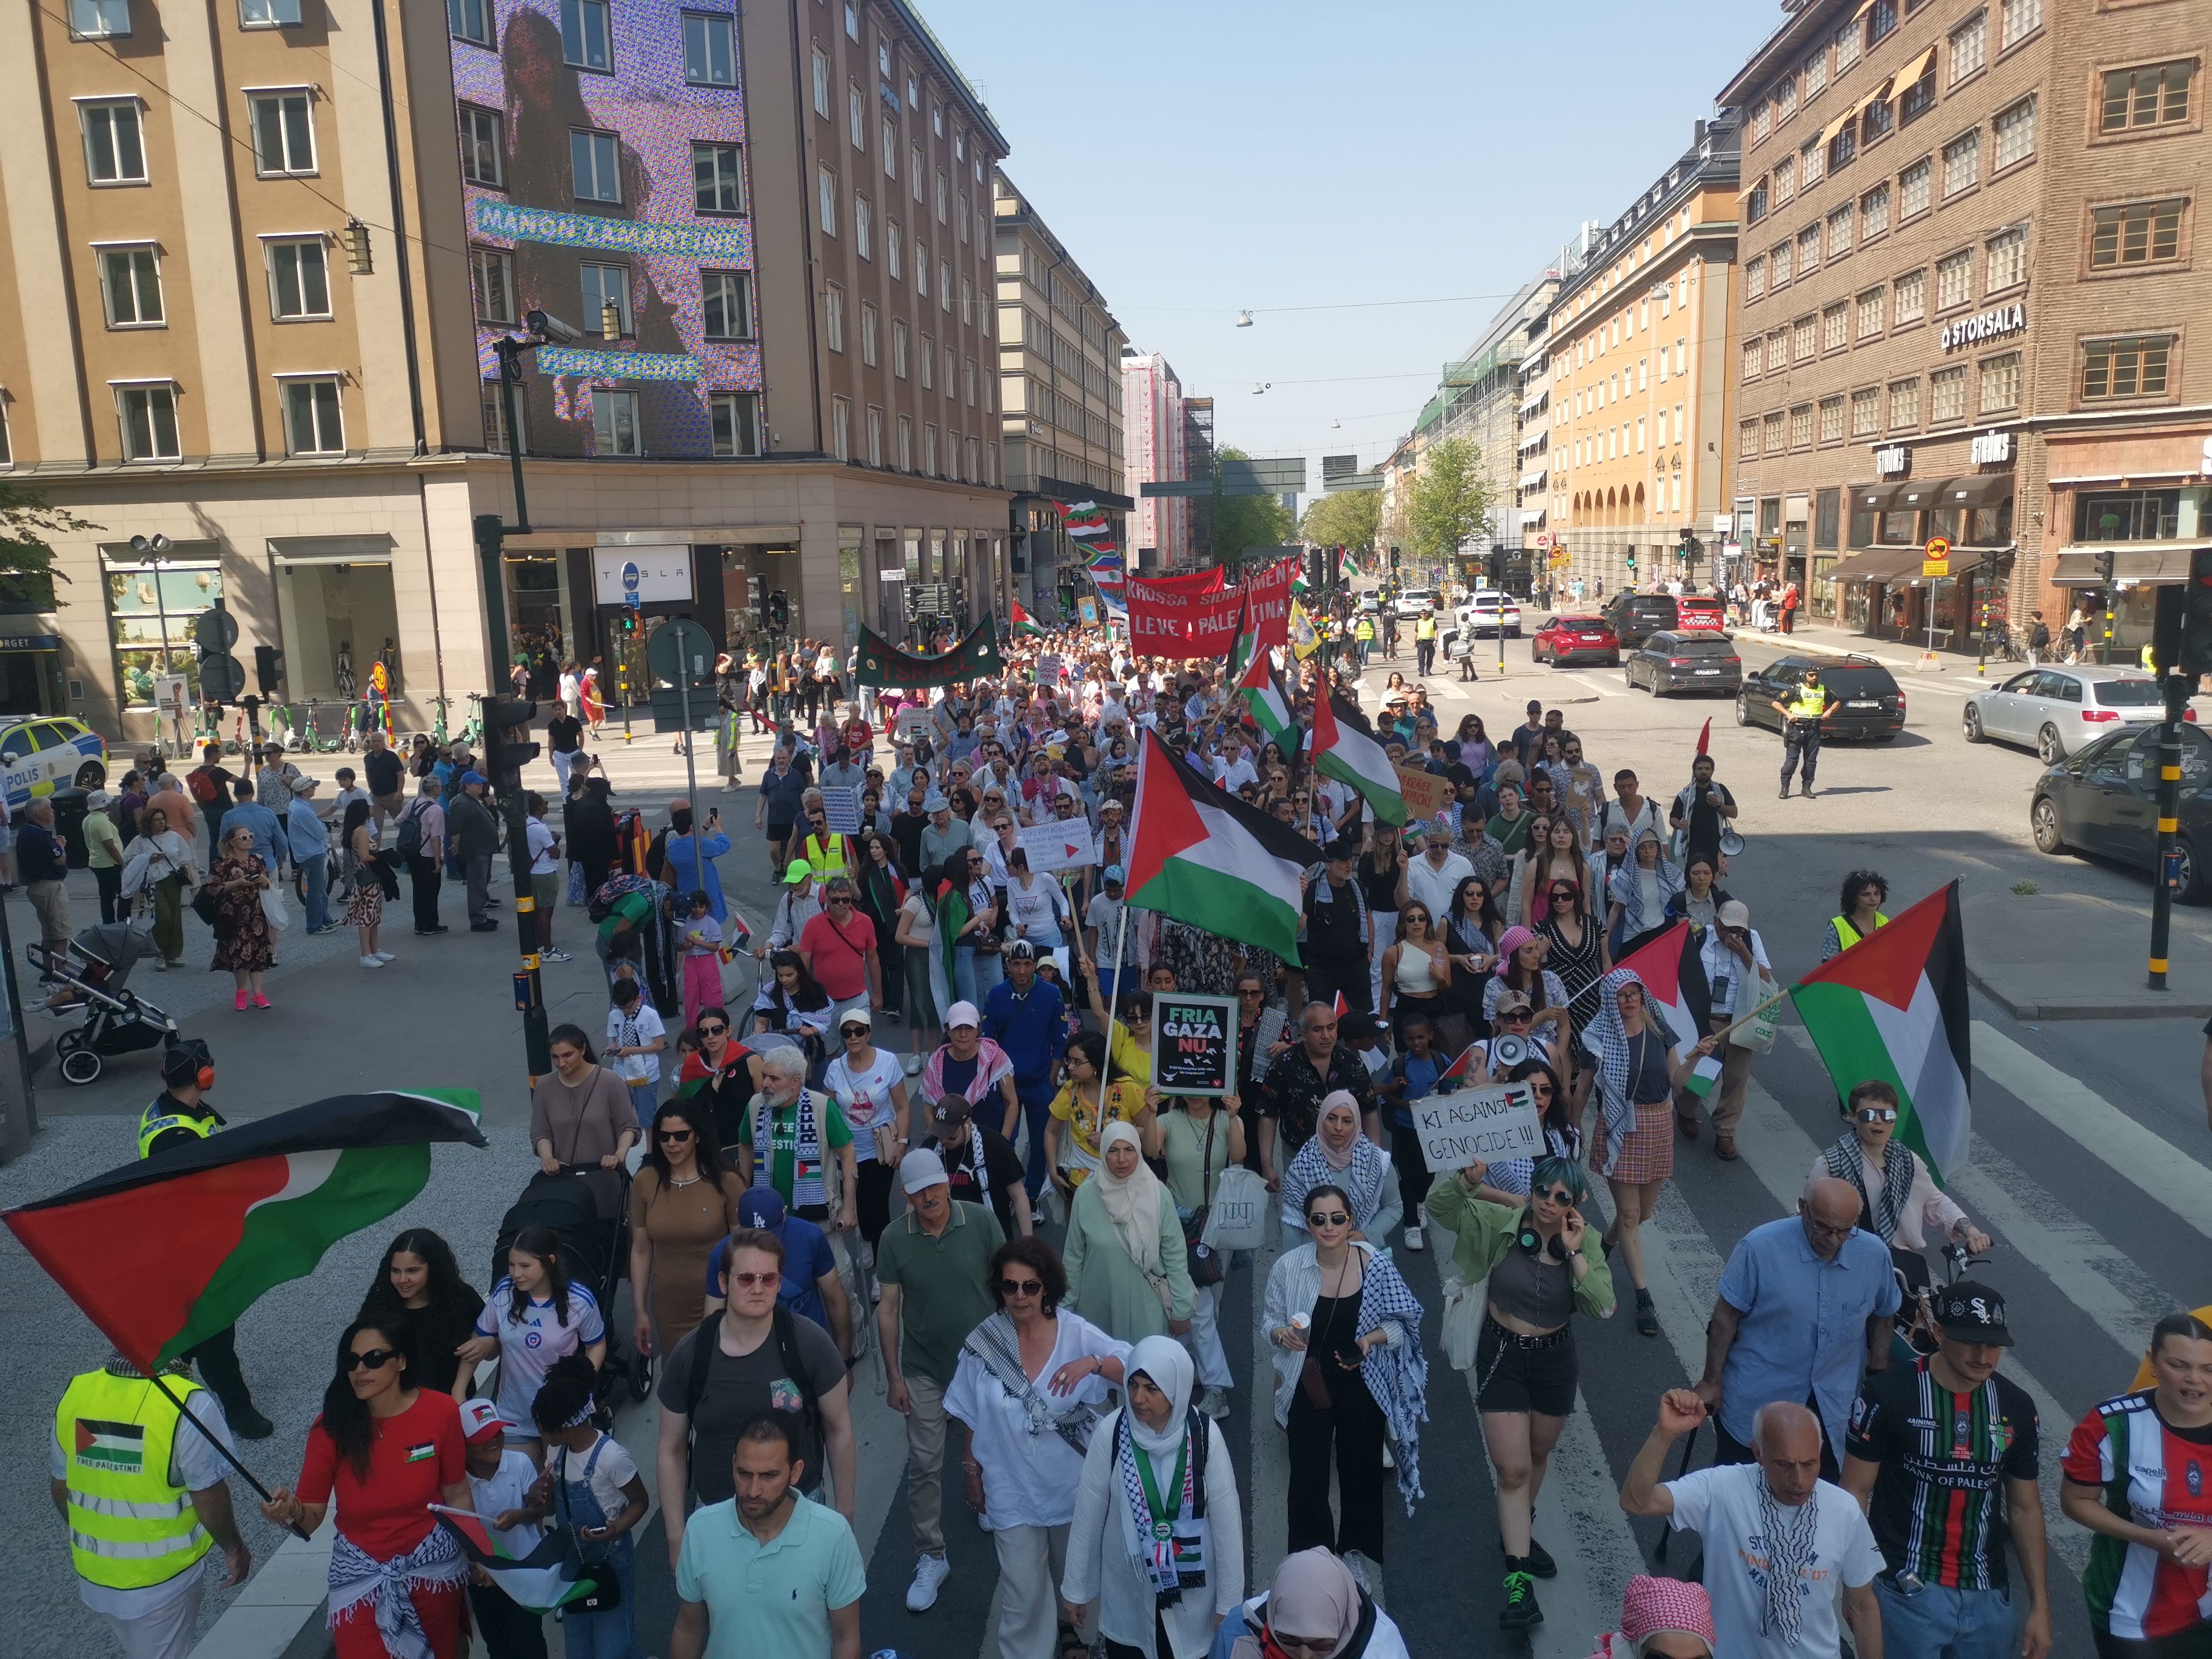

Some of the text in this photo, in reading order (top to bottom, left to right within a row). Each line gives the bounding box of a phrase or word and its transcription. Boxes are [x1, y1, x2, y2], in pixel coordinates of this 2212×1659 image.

[1952, 303, 2022, 345] STORSALA
[1971, 430, 2009, 464] STRÖMS
[1877, 445, 1904, 474] STRÖMS
[603, 569, 671, 579] TSLA
[1127, 579, 1188, 606] KROSSA
[1136, 598, 1286, 637] LEVE PALETINA
[375, 670, 384, 685] 40
[884, 654, 974, 682] ISRAEL
[6, 768, 39, 789] POLIS
[1170, 1008, 1217, 1024] FRIA
[1163, 1022, 1222, 1039] GAZA
[1179, 1038, 1207, 1053] NU
[1422, 1099, 1508, 1129] KI AGAINST
[772, 1140, 793, 1150] ESTI
[1429, 1130, 1517, 1159] GENOCIDE
[1907, 1418, 1936, 1426] RAINING
[1182, 1436, 1193, 1506] ESTINE
[1903, 1463, 1934, 1482] BANK
[1938, 1476, 1954, 1486] OF
[2135, 1466, 2167, 1478] capelli
